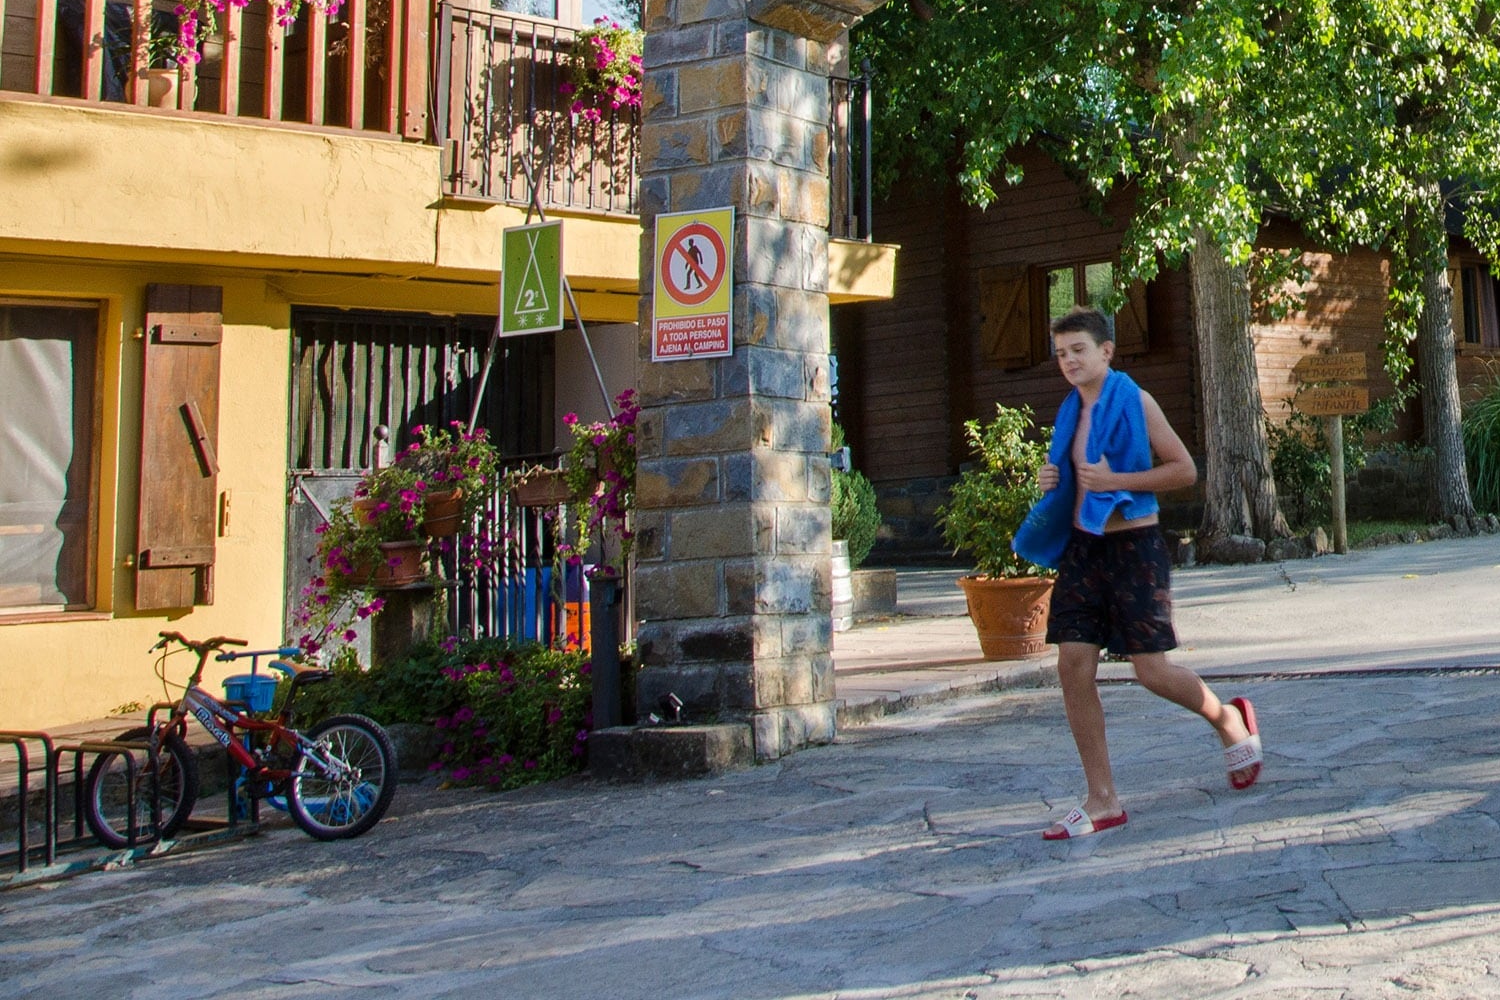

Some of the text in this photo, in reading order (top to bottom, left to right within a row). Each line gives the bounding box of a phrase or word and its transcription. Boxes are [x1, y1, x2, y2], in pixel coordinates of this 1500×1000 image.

[658, 317, 726, 332] PROHIBIDO EL PASO
[662, 329, 722, 342] A TODA PERSONA
[659, 340, 725, 354] AJENA AL CAMPING
